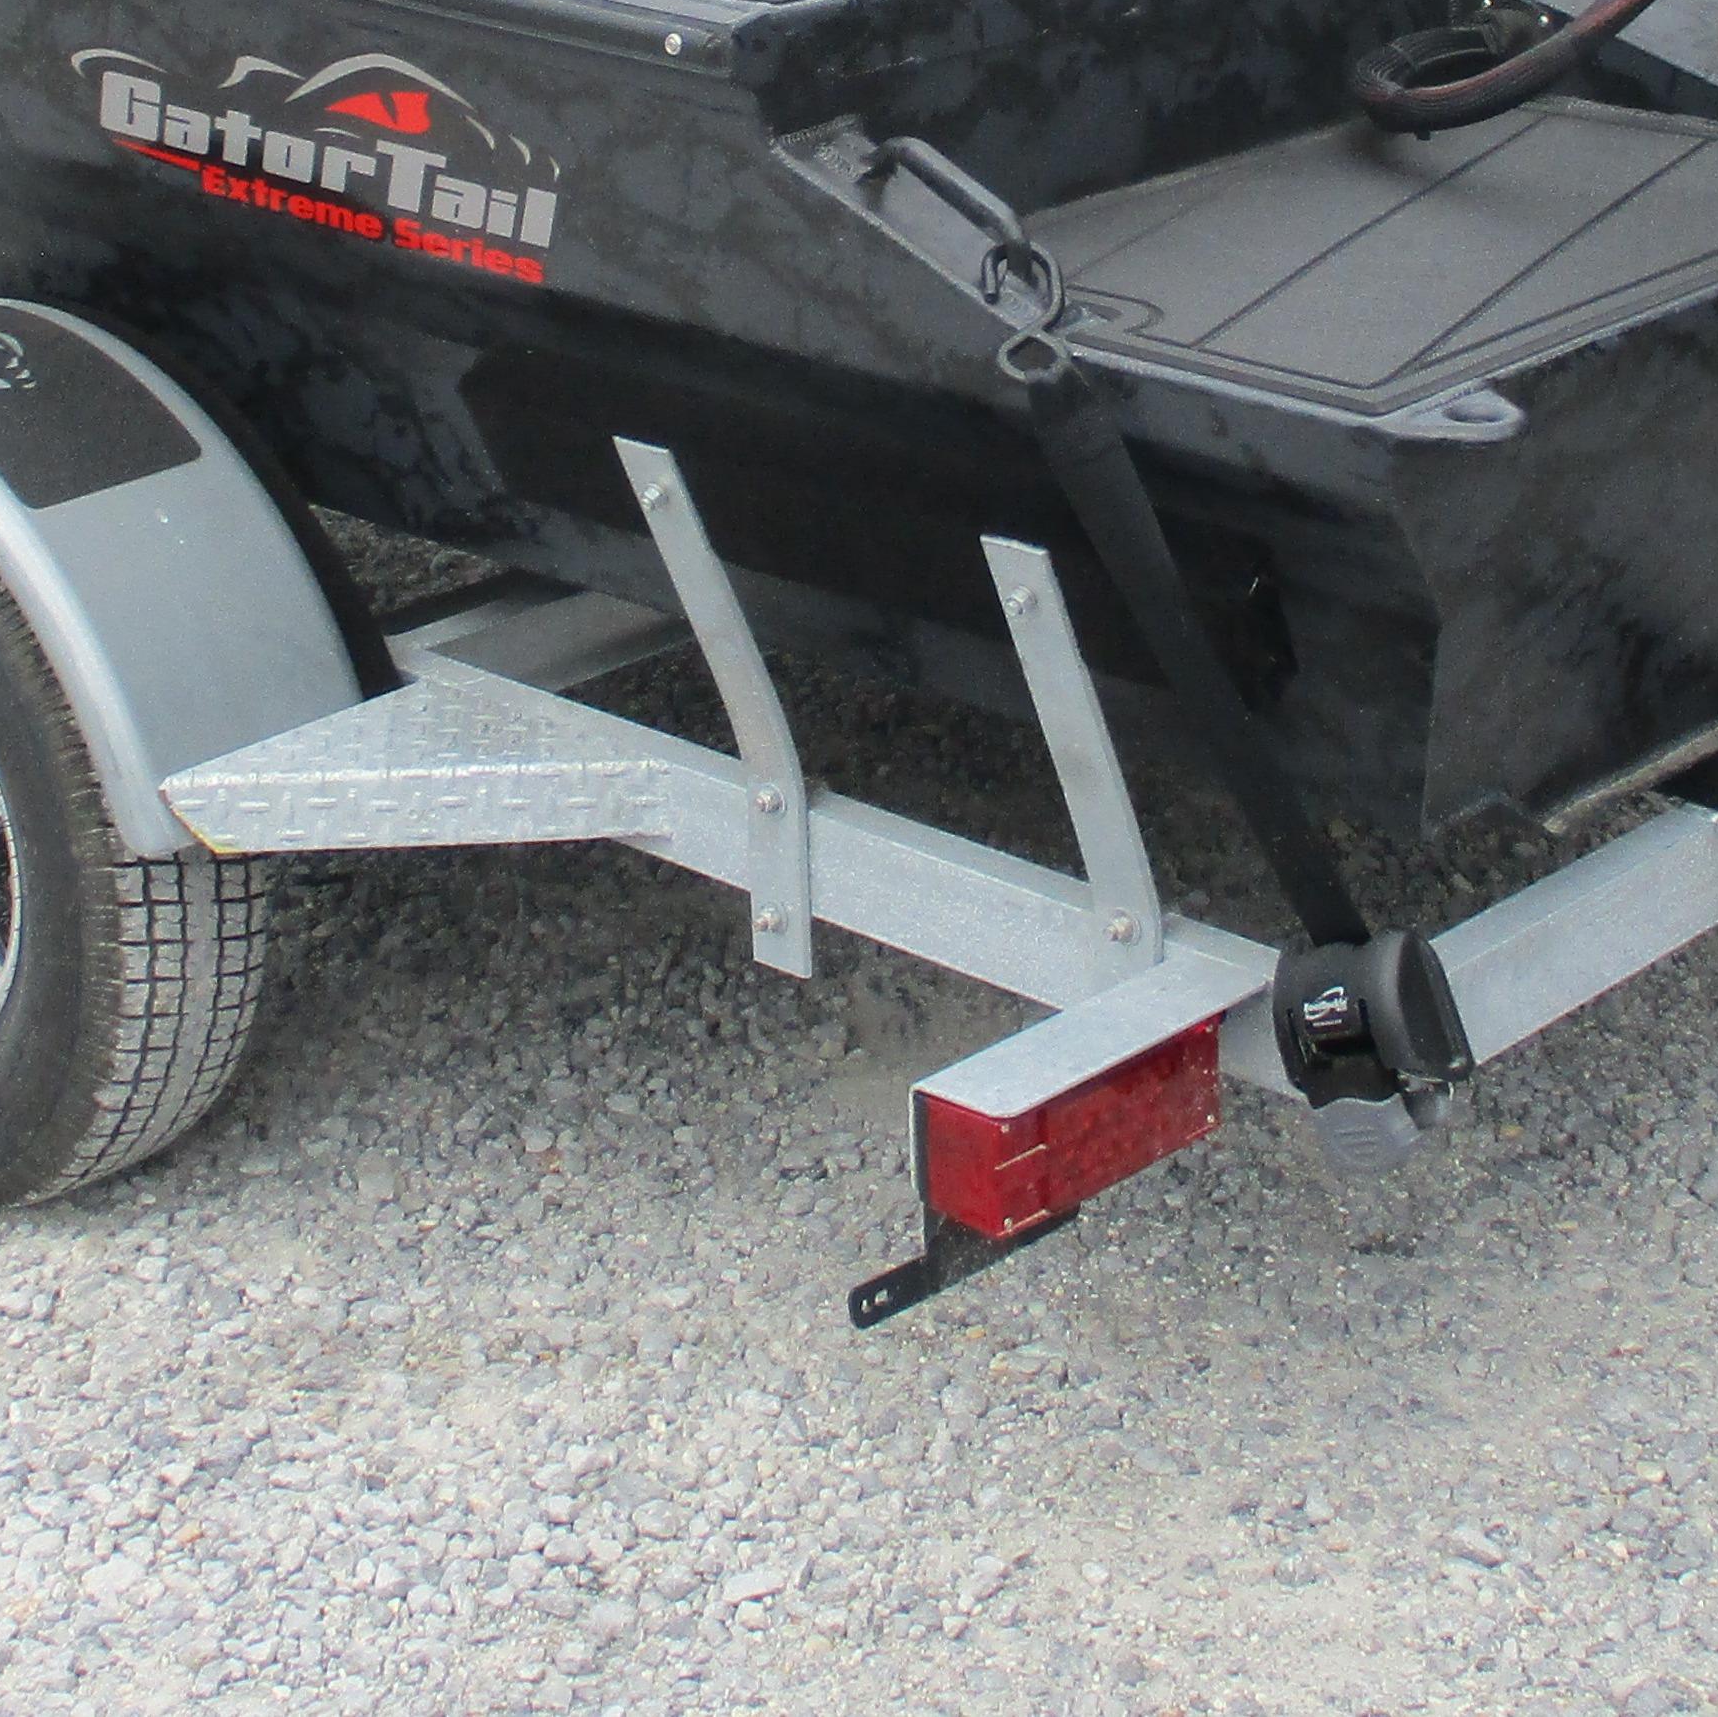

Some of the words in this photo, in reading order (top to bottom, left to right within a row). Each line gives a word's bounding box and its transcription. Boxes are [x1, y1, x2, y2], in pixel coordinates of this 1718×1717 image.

[99, 69, 558, 250] GatorTail
[198, 165, 384, 242] Extreme
[392, 218, 545, 283] Series
